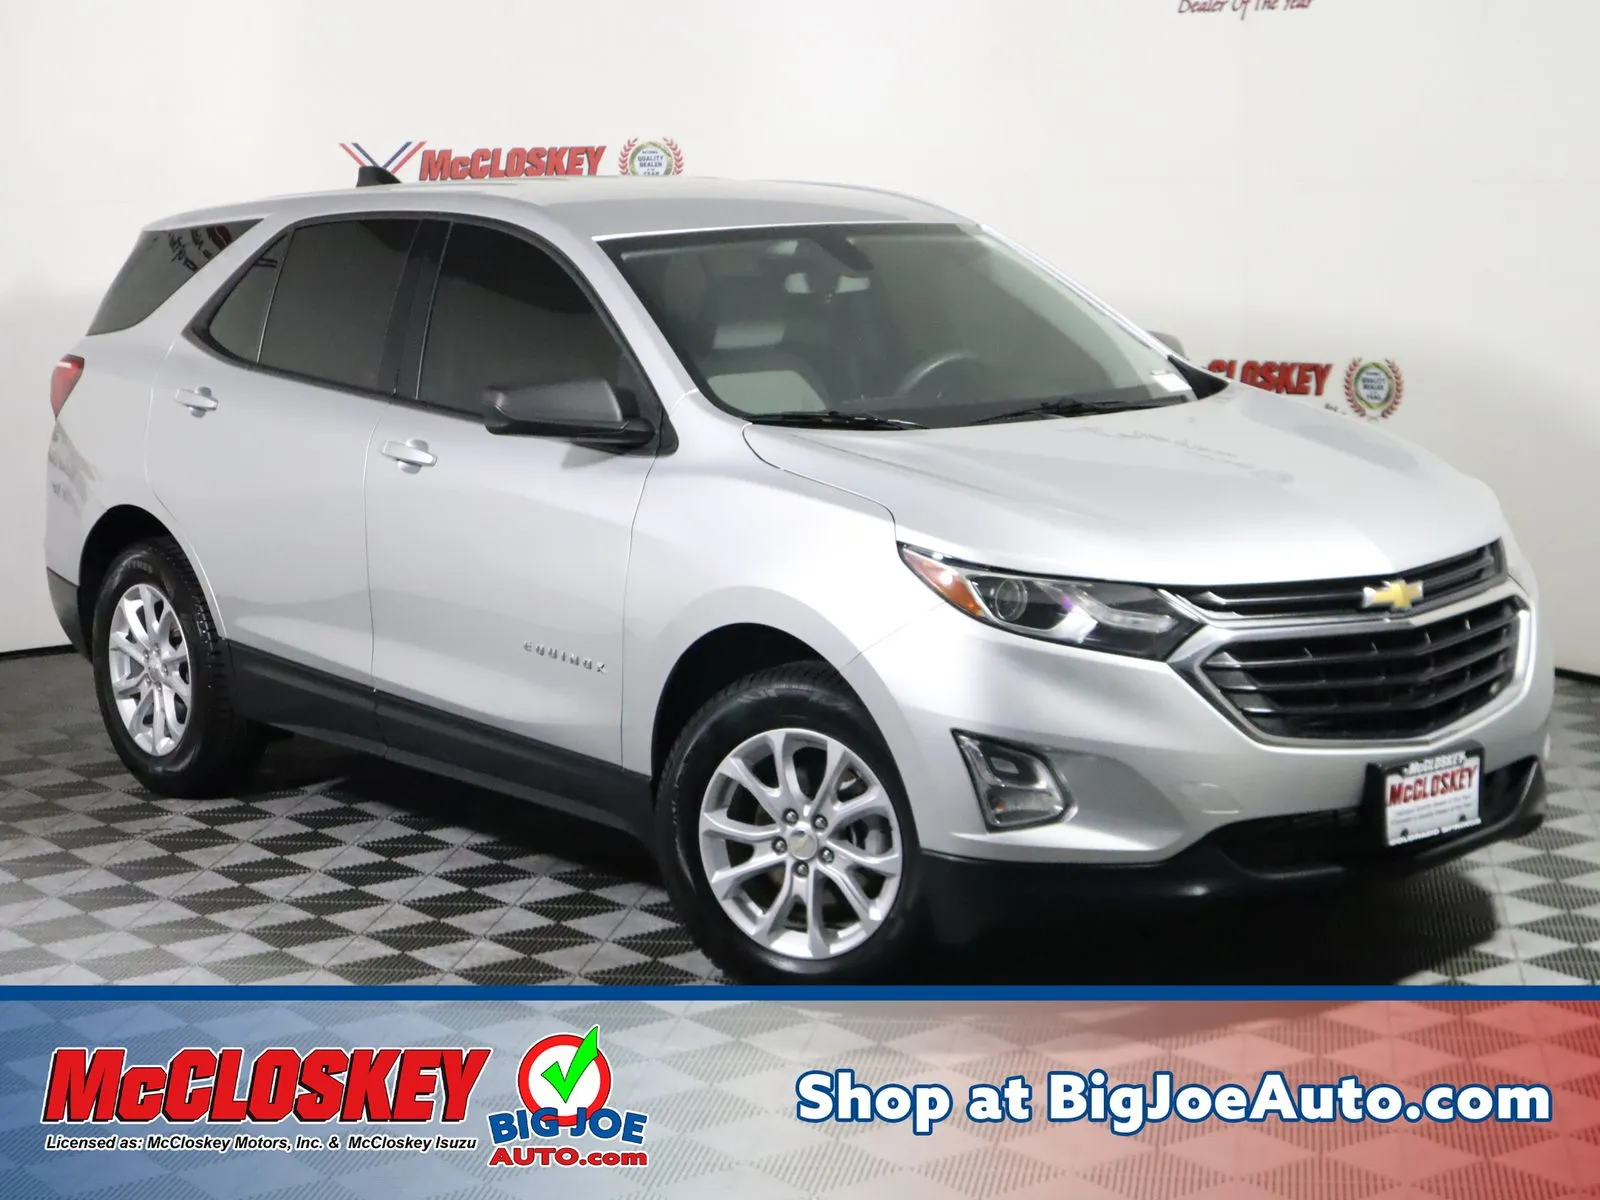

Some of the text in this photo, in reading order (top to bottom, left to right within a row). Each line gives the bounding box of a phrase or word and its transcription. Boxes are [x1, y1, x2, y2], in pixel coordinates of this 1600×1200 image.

[1178, 0, 1229, 13] Dealer
[418, 145, 607, 181] McCLOSKEY
[523, 640, 606, 675] EQUINOX
[1388, 764, 1478, 806] McCLOSKEY
